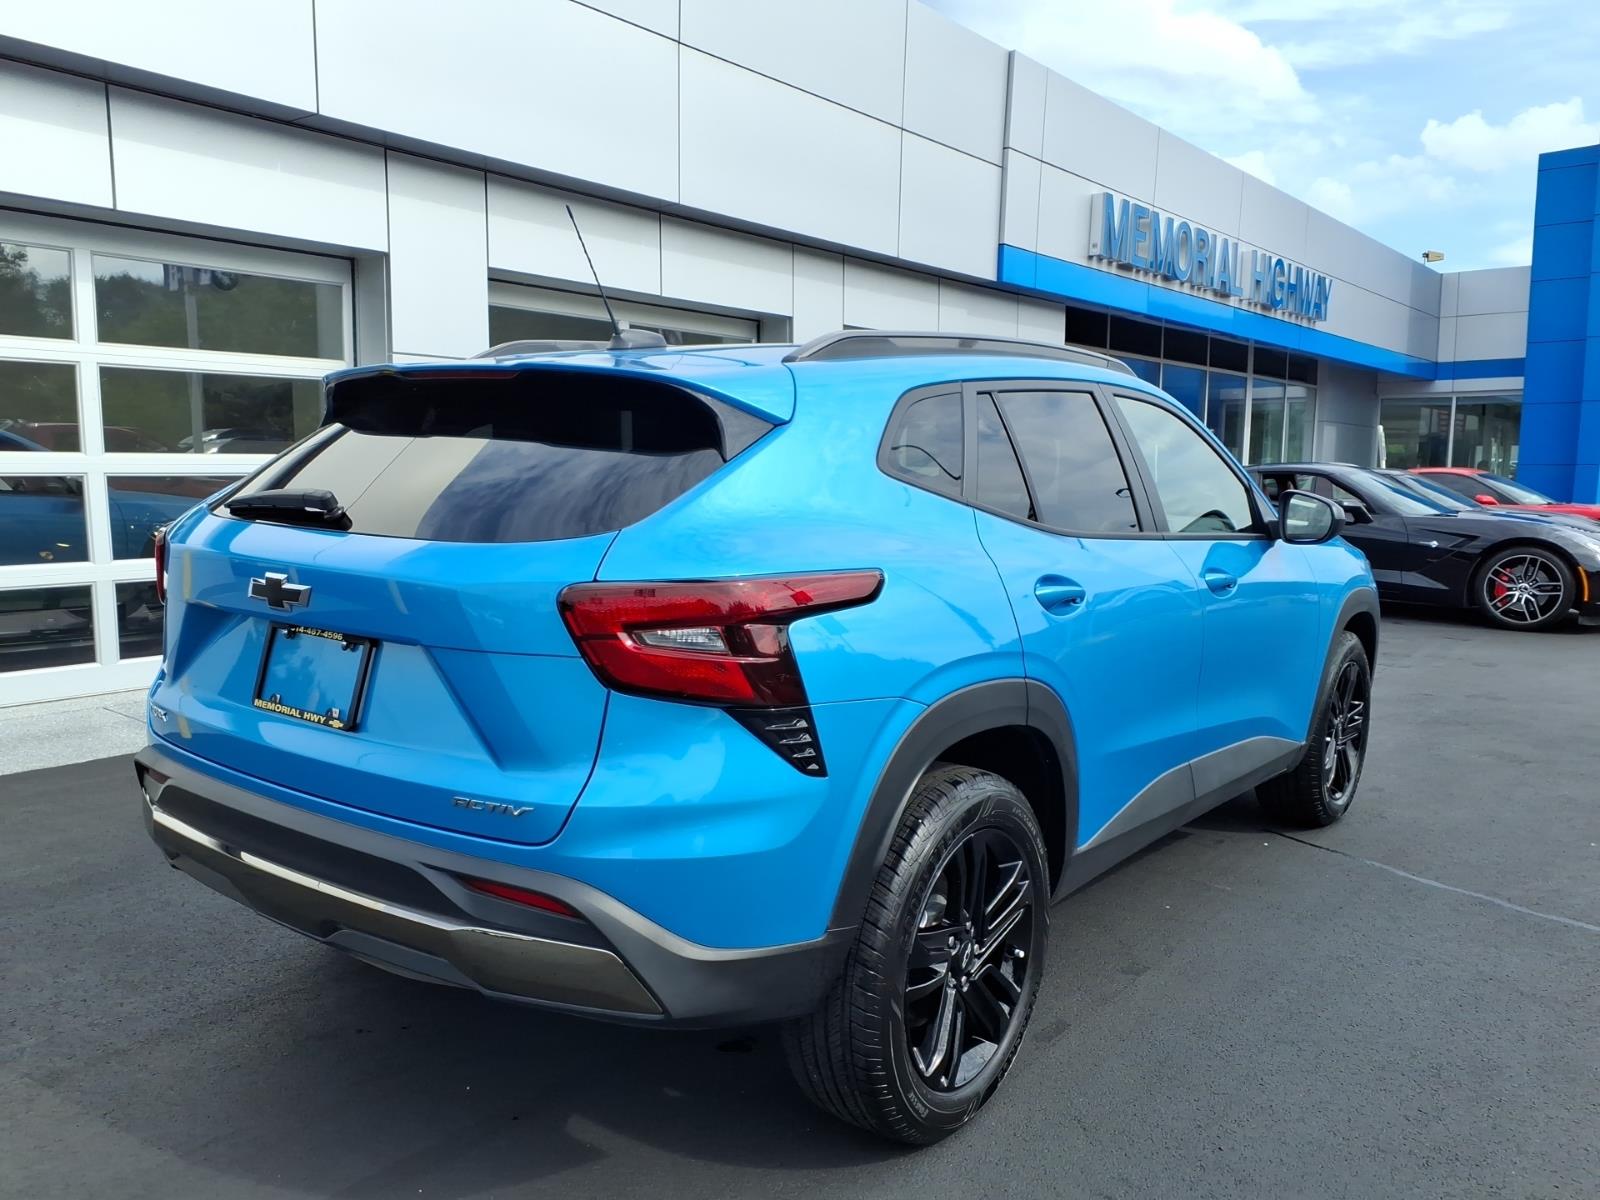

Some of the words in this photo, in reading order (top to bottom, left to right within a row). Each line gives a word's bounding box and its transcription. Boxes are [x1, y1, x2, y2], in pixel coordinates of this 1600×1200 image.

[1090, 191, 1243, 298] MEMORIAL
[1246, 249, 1333, 322] HIGHWAY
[254, 698, 302, 718] MEMORIAL
[303, 711, 327, 724] HWY
[452, 796, 535, 816] ACTIV
